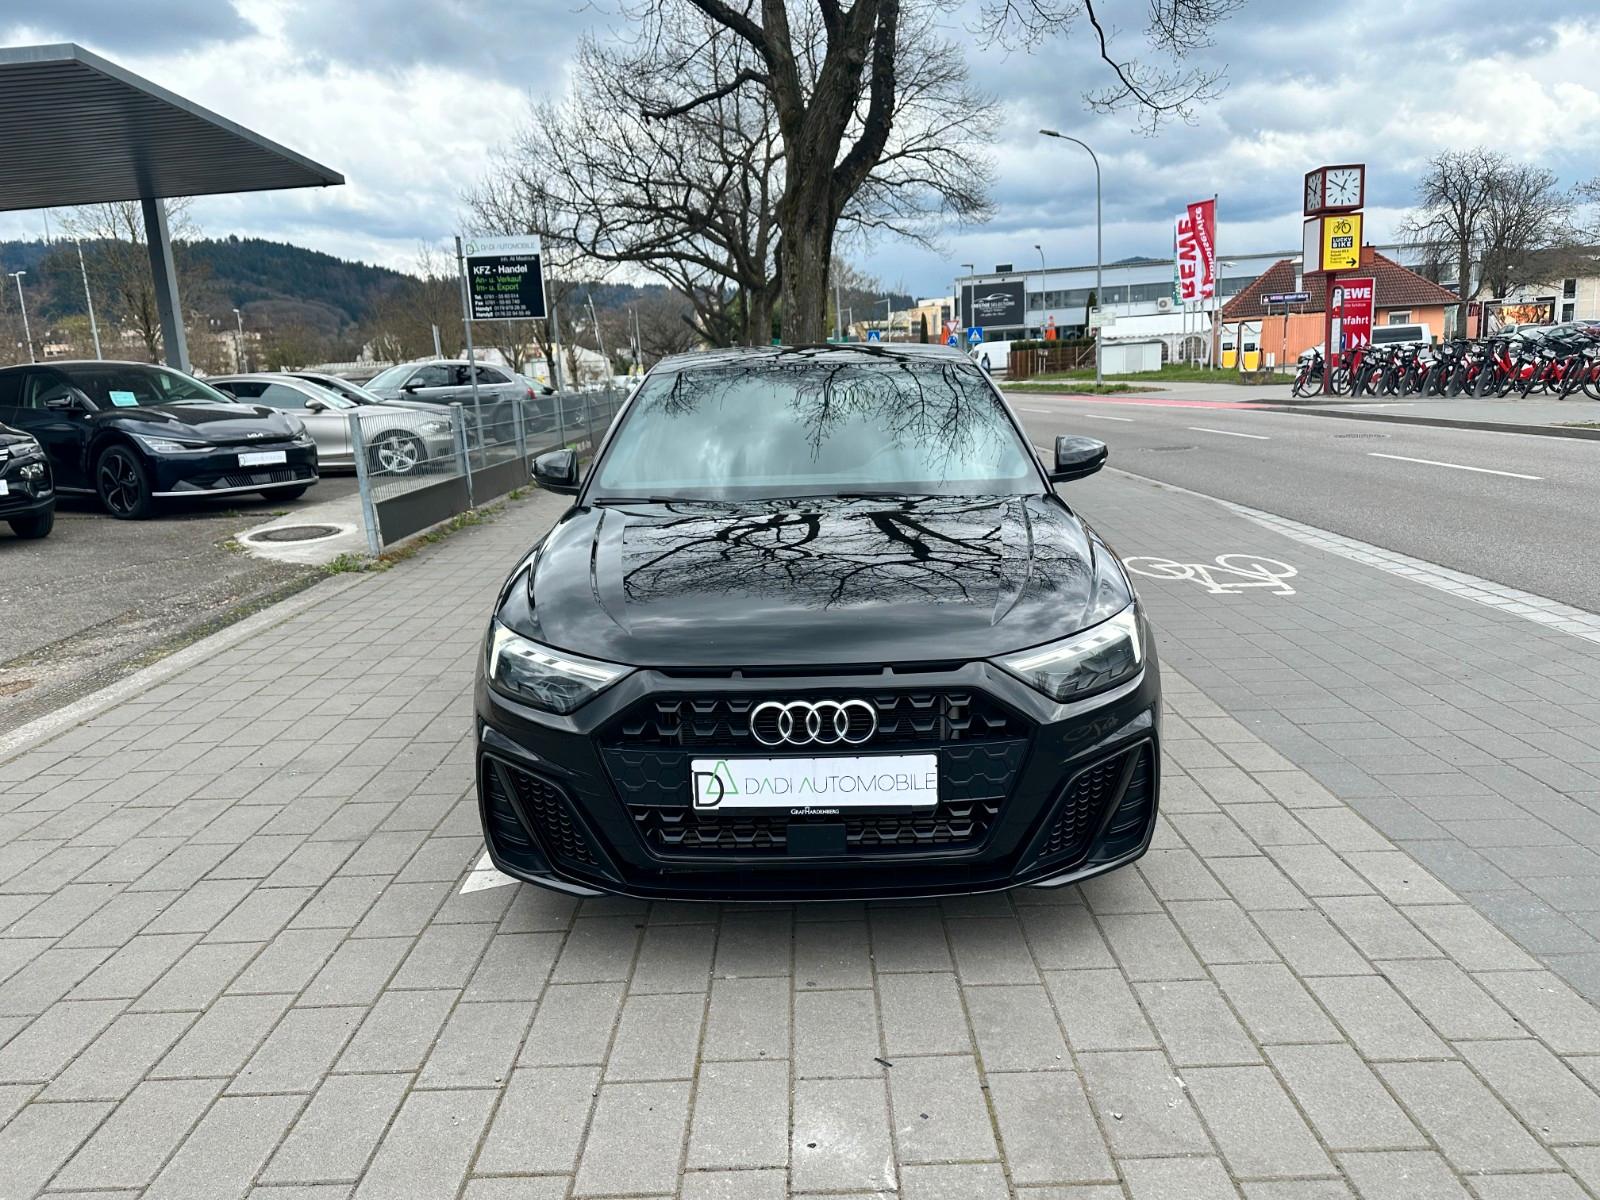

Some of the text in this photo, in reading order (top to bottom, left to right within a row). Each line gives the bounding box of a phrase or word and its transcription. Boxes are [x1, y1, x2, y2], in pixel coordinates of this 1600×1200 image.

[473, 265, 491, 275] KFZ
[498, 264, 528, 273] Handel
[497, 275, 522, 283] Verkauf
[497, 283, 519, 292] Export
[1334, 287, 1371, 300] REWE
[1343, 315, 1369, 325] nfahrt
[745, 772, 937, 795] DADI AUTOMOBILE
